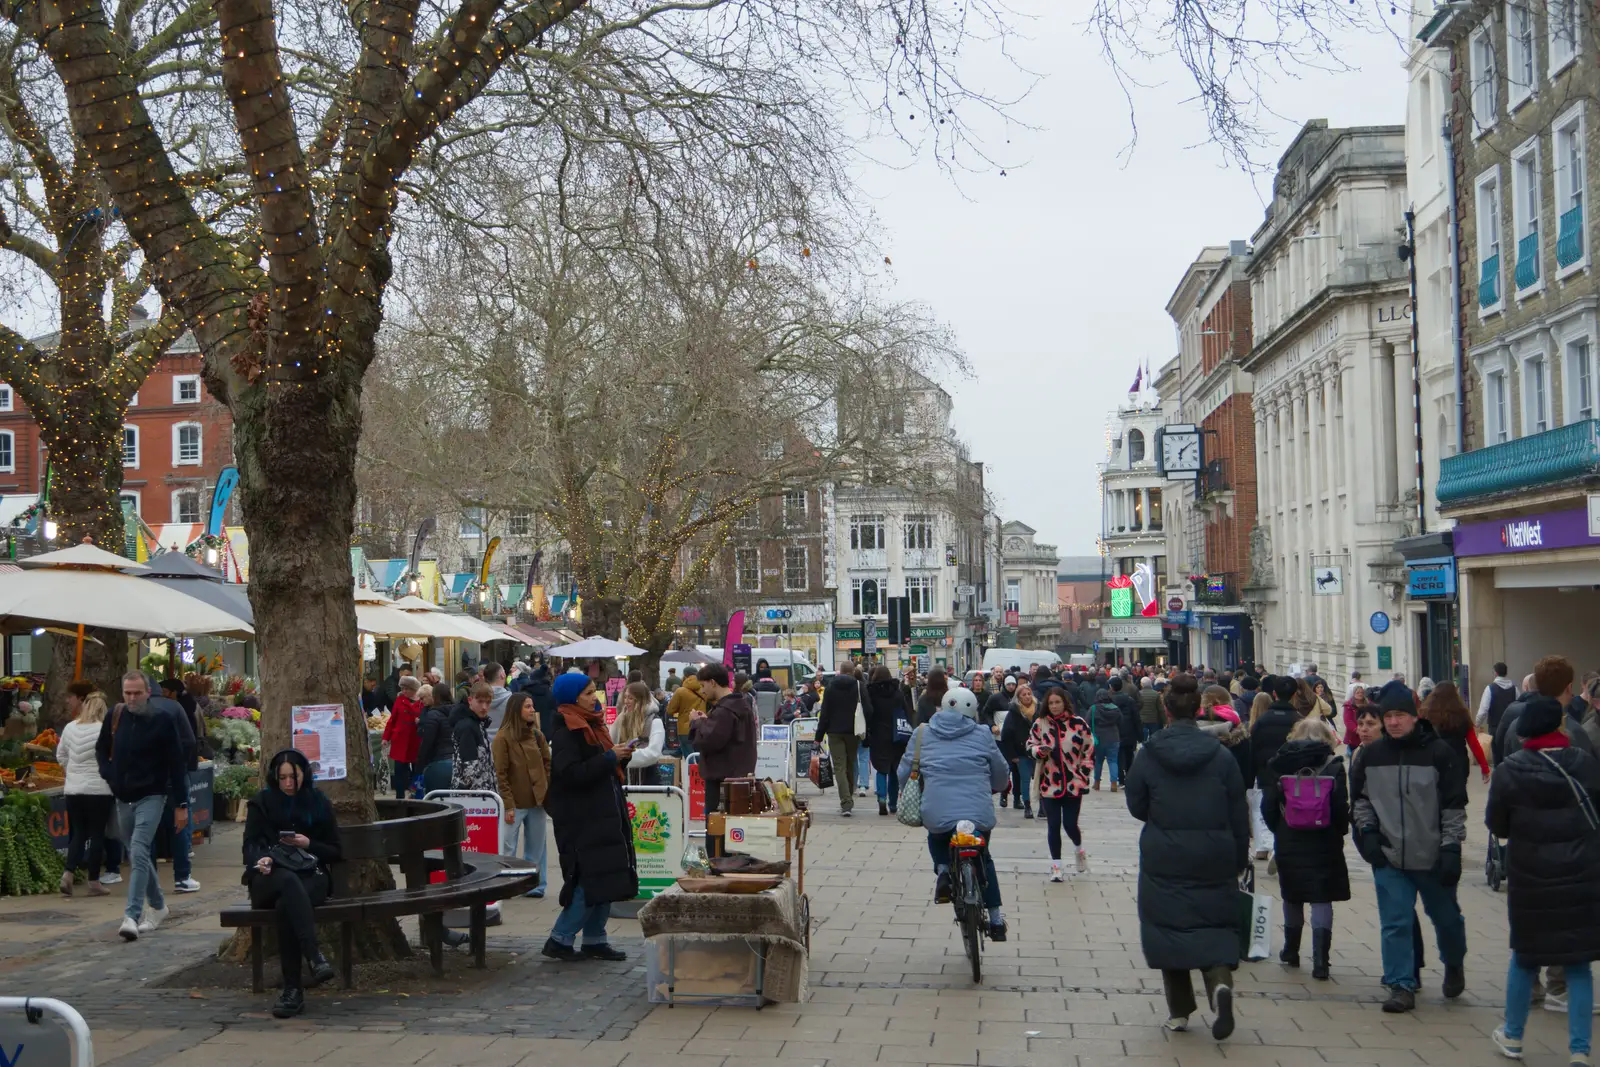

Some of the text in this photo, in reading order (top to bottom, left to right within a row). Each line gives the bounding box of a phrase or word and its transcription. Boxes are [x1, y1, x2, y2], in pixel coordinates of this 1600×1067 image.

[1508, 520, 1543, 548] NatWest
[1411, 581, 1444, 590] NERO
[767, 609, 791, 619] TSB
[837, 629, 861, 639] E-CIGS
[921, 627, 945, 637] PAPERS
